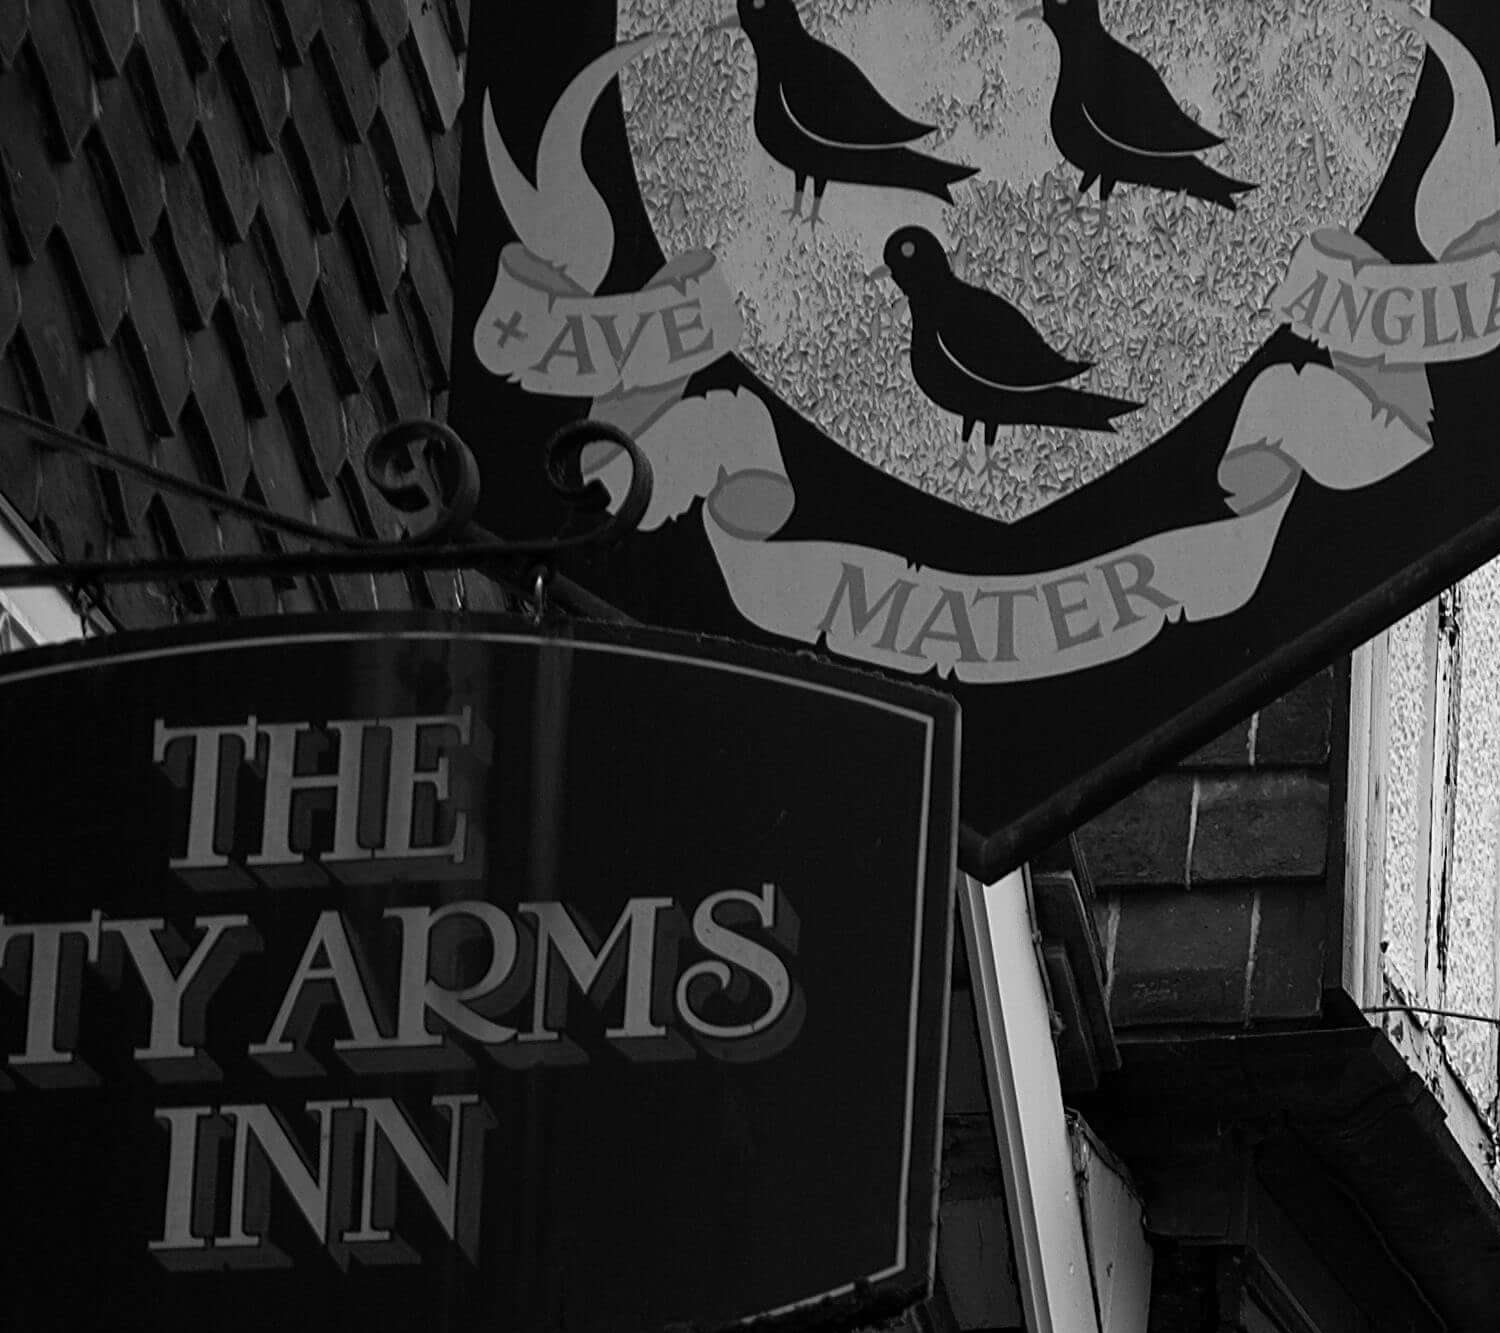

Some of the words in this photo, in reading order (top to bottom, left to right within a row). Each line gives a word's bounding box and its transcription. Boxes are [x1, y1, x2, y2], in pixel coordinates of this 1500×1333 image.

[528, 300, 715, 376] AVE
[815, 550, 1181, 665] MATER
[153, 705, 474, 871] THE
[250, 882, 795, 1056] ARMS
[148, 1093, 480, 1252] INN
